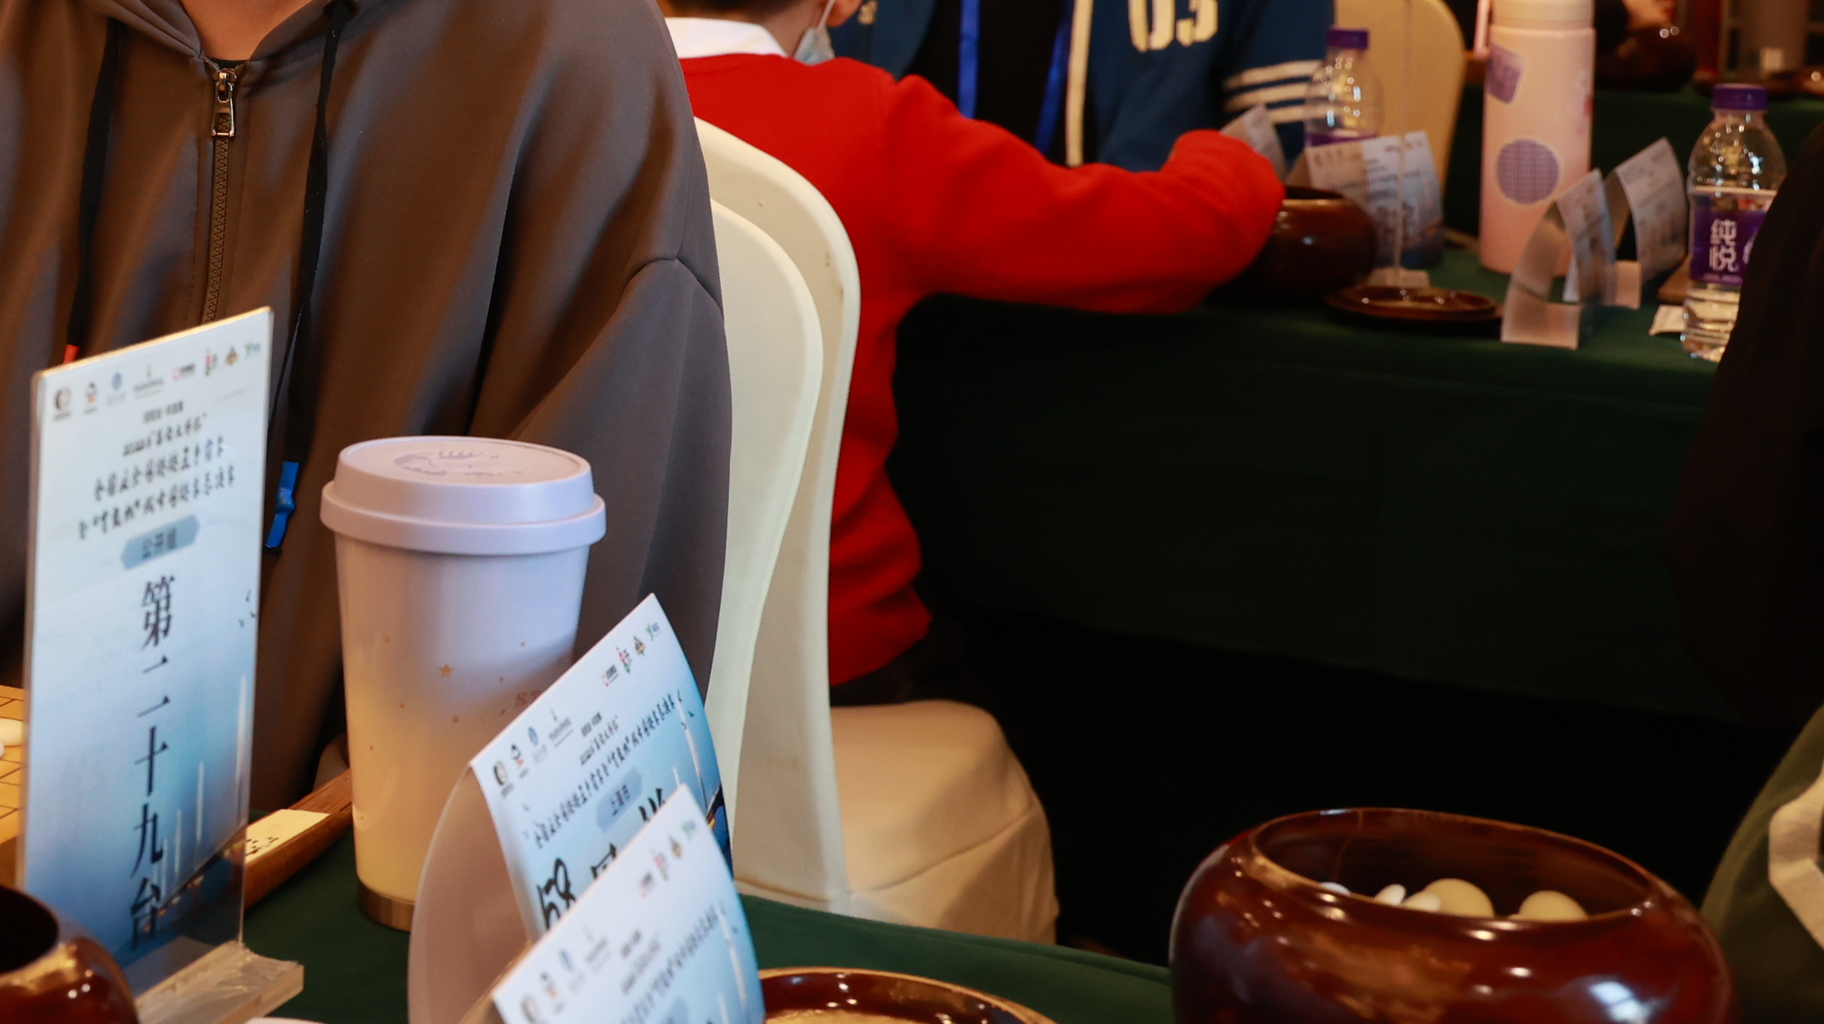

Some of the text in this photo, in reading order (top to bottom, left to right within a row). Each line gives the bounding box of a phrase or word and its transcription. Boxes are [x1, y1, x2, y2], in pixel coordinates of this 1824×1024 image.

[1709, 218, 1738, 272] 纯悦
[129, 575, 176, 951] 第二十九台
